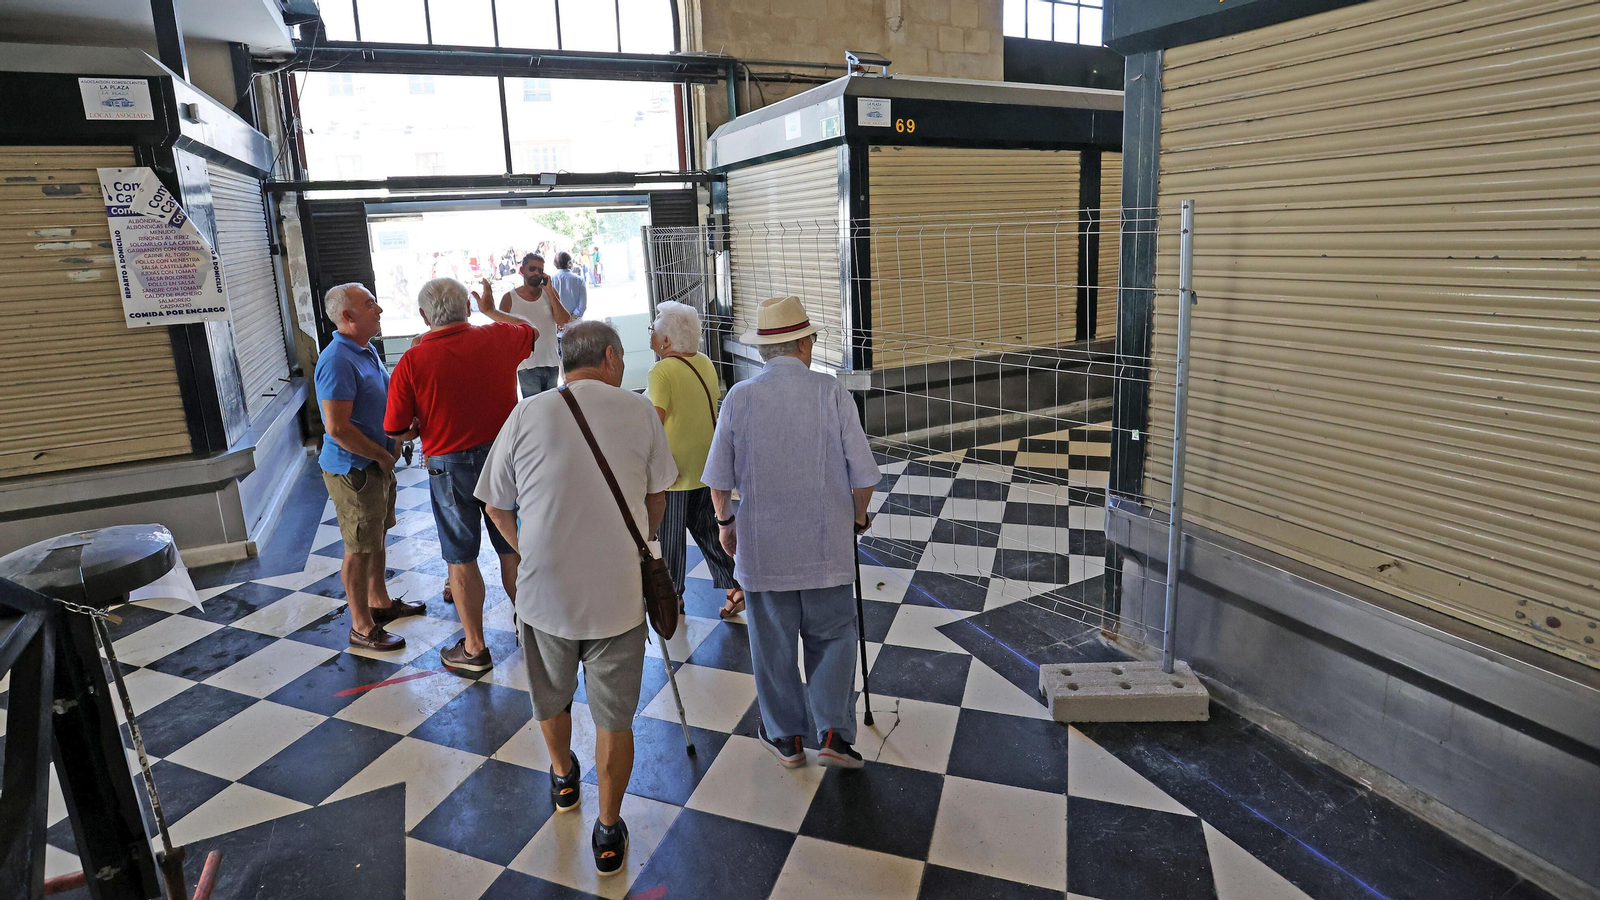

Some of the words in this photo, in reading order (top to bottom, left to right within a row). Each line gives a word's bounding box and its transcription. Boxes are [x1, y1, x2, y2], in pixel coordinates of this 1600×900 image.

[895, 118, 916, 133] 69
[115, 230, 126, 263] DOMICILIO
[122, 270, 132, 298] REPARTO
[213, 262, 222, 293] DOMICILIO
